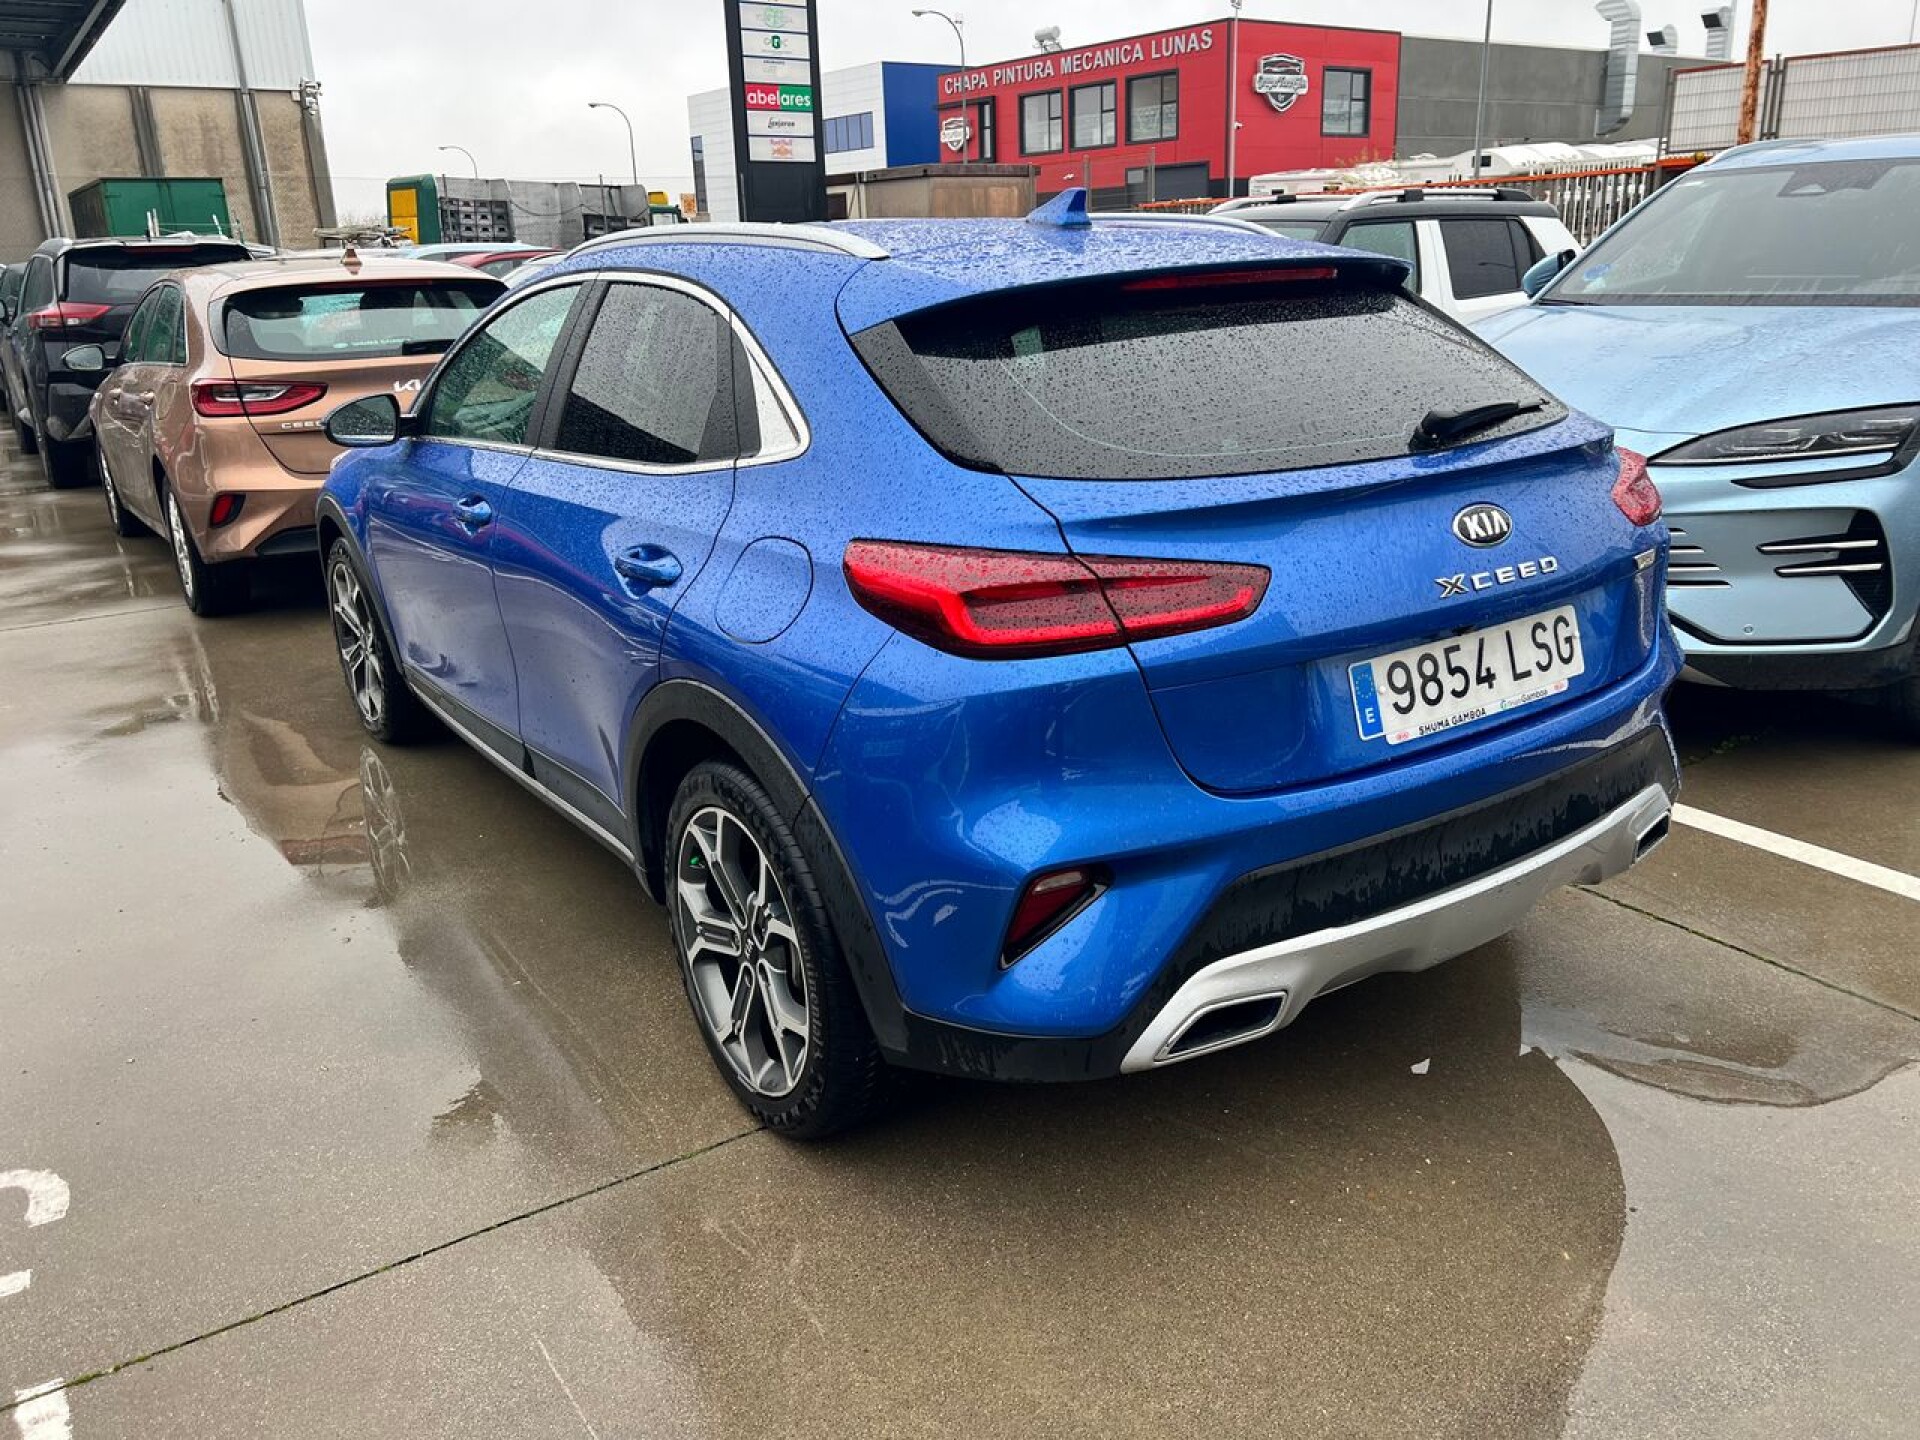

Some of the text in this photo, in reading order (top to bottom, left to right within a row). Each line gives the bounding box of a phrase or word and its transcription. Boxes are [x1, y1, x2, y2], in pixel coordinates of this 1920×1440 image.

[944, 29, 1213, 94] CHAPA PINTURA MECANICA LUNAS
[747, 90, 811, 106] abelares
[1462, 510, 1509, 539] KIA
[1434, 556, 1558, 598] XCEED
[1386, 614, 1575, 715] 9854 LSG
[1365, 707, 1375, 724] E
[1418, 707, 1487, 736] SHUMA GAMBOA
